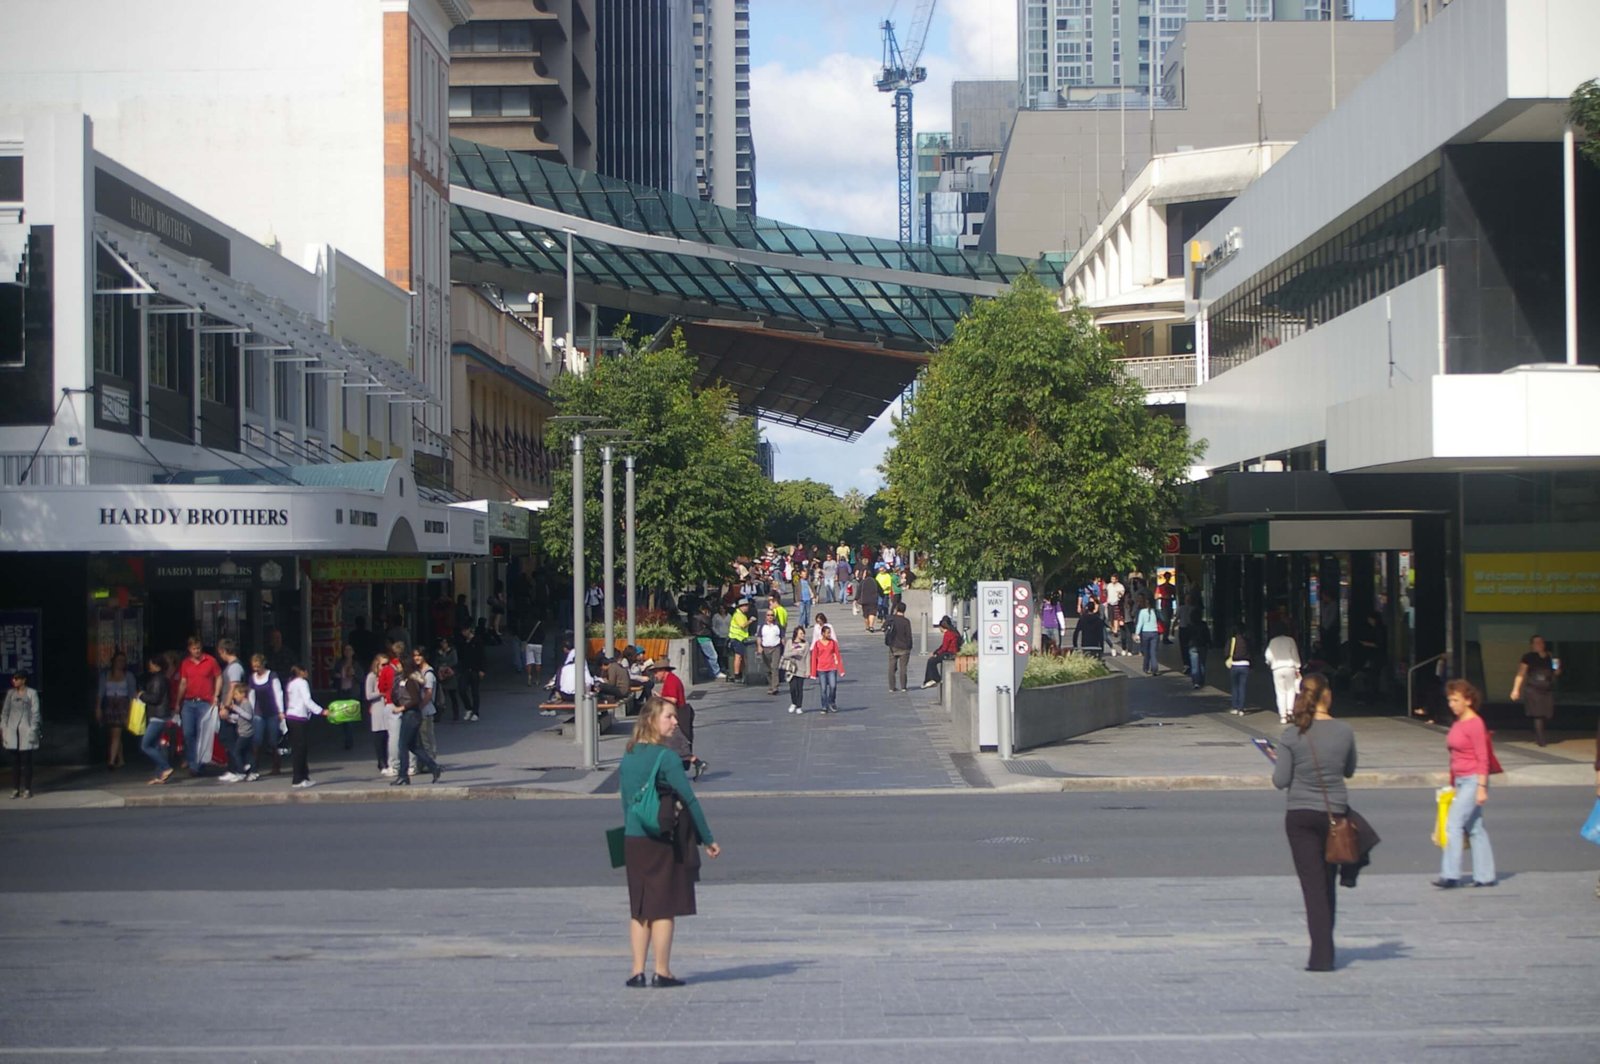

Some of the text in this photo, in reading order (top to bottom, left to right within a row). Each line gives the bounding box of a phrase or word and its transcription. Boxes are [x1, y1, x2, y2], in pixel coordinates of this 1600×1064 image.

[130, 196, 192, 247] HARDY BROTHERS
[99, 508, 288, 526] HARDY BROTHERS
[157, 567, 193, 577] HARDY
[987, 598, 1003, 606] WAY
